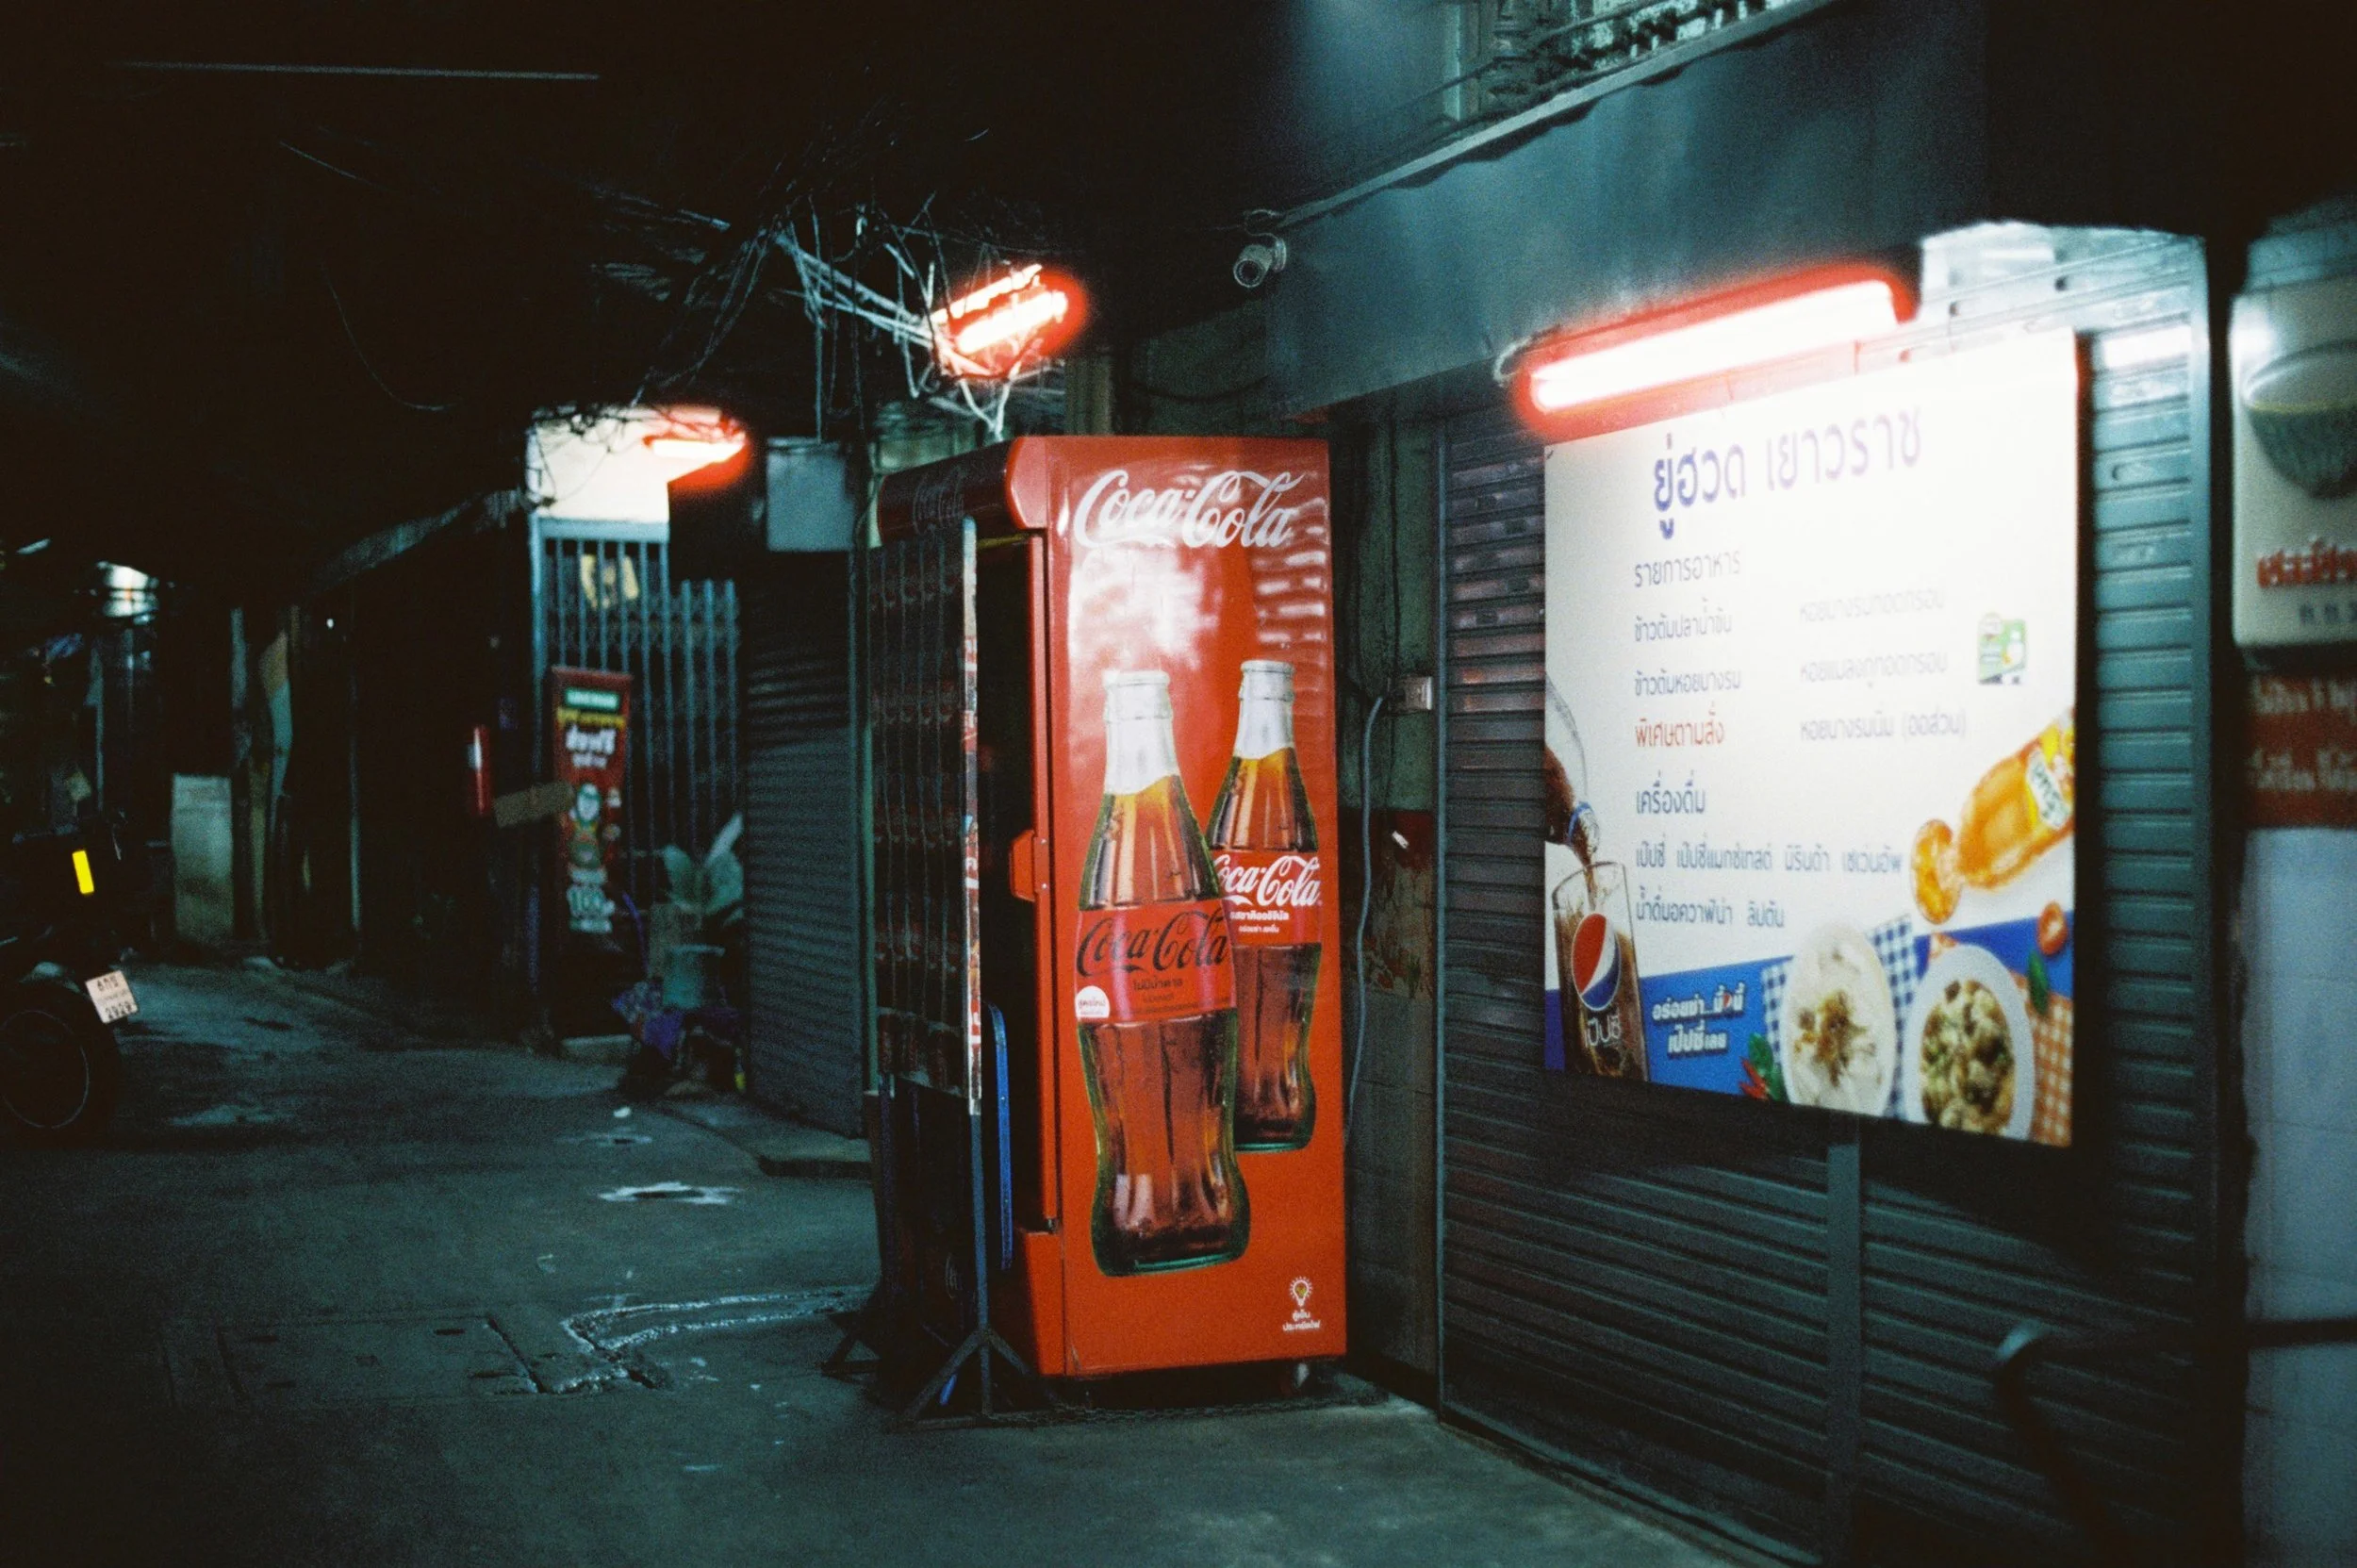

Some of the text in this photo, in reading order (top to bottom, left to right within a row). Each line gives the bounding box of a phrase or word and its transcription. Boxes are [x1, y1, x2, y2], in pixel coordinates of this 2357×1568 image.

[1653, 407, 1921, 540] ยู่ฮวด เยาวราช
[1073, 470, 1305, 549] Coca-Cola
[1634, 549, 1741, 588] รายการอาหาร
[1634, 668, 1741, 697] ข้าวต้มหอยนางรม
[1635, 701, 1725, 749] พิเศษตามสั่ง
[1636, 769, 1706, 816] เครื่องดื่ม
[1077, 907, 1228, 977] Coca-Cola
